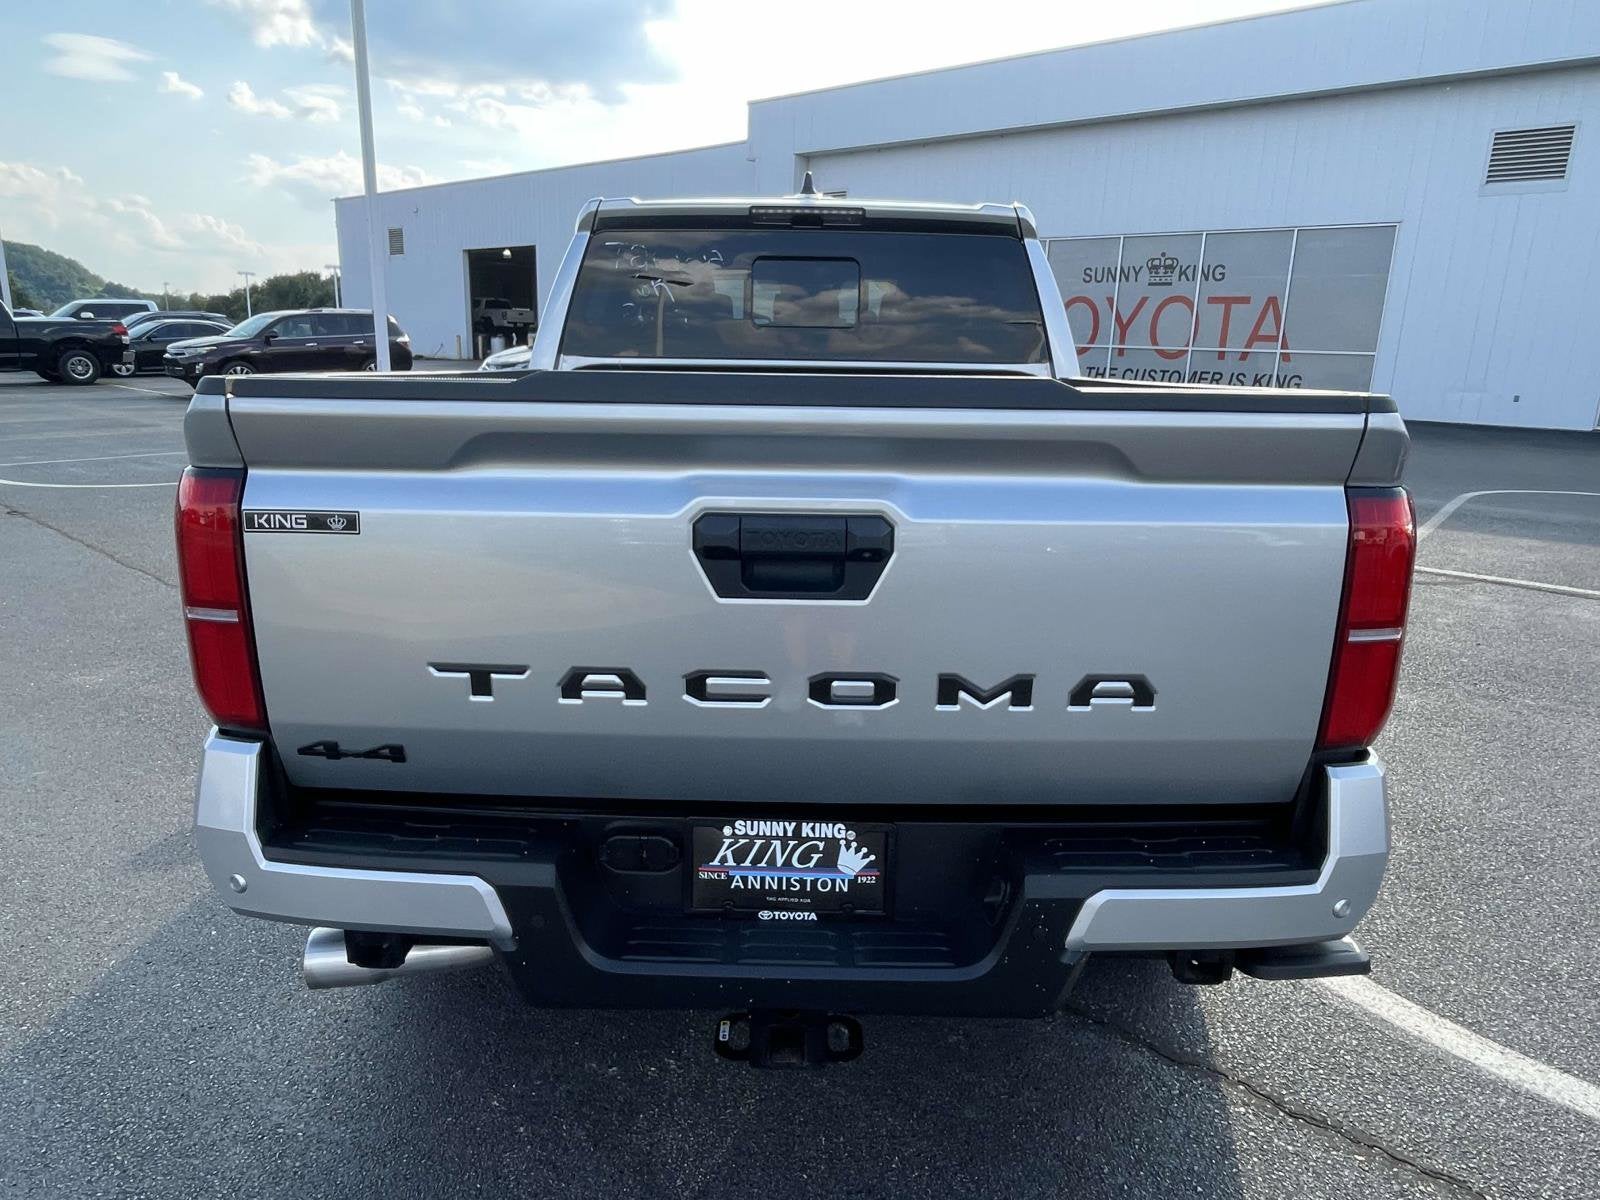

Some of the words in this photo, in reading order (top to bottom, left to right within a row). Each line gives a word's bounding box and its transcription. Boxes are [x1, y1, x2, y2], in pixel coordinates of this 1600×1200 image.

[1082, 265, 1144, 284] SUNNY
[1178, 264, 1226, 282] KING
[1063, 295, 1292, 362] OYOTA
[1085, 366, 1118, 380] THE
[1122, 367, 1223, 386] CUSTOMER
[1228, 371, 1247, 387] IS
[1251, 373, 1303, 389] KING
[253, 514, 307, 529] KING
[427, 662, 1159, 713] TACOMA
[734, 819, 796, 838] SUNNY
[801, 822, 846, 839] KING
[709, 838, 825, 868] KING
[698, 871, 728, 881] SINCE
[857, 875, 876, 884] 1922
[730, 875, 849, 893] ANNISTON
[773, 911, 818, 921] TOYOTA
